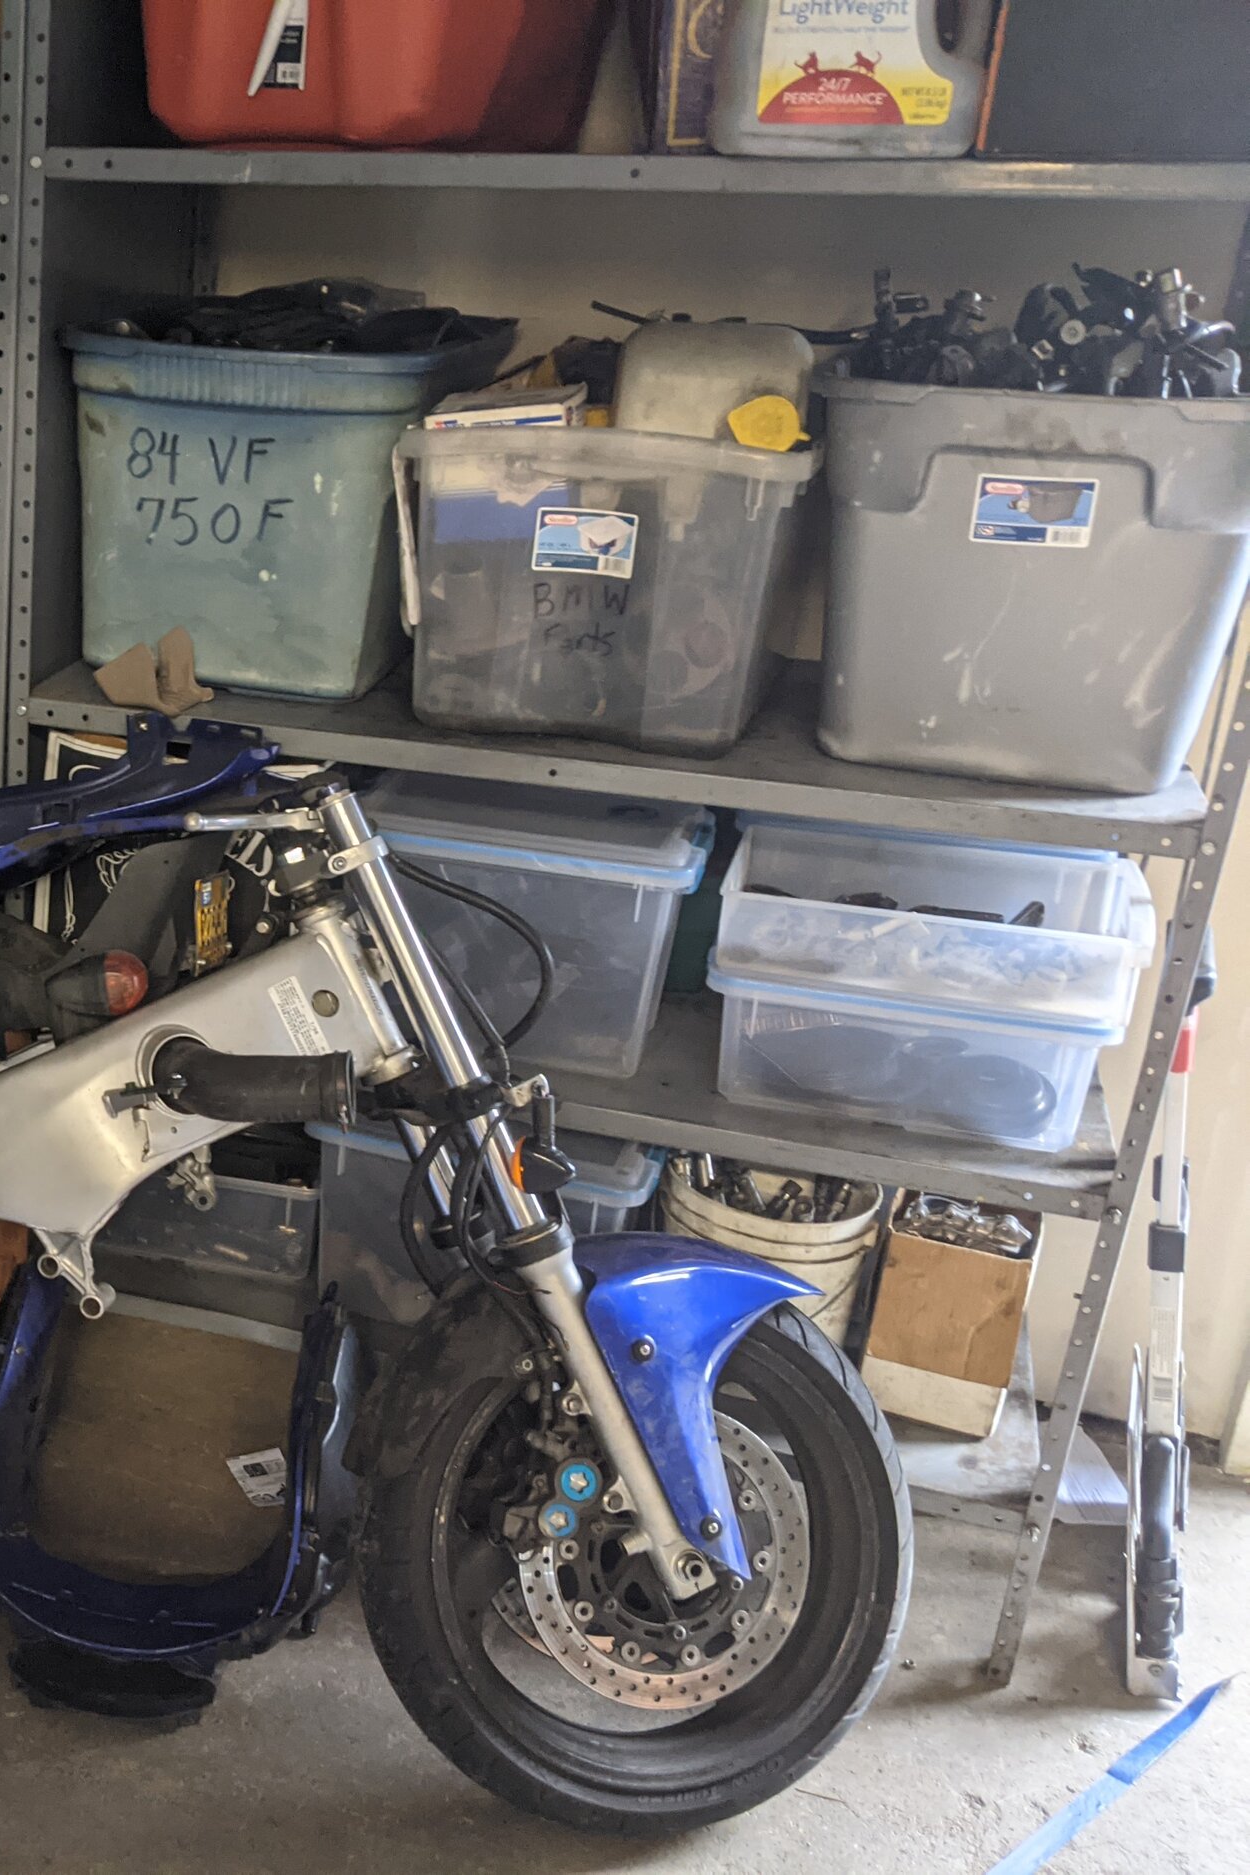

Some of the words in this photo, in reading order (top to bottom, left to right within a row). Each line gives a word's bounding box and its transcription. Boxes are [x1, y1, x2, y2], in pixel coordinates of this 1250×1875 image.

[779, 0, 908, 24] LightWeight
[818, 77, 852, 91] 24/7
[782, 92, 885, 106] PERFORMANCE
[127, 427, 180, 485] 84
[209, 436, 277, 485] VF
[533, 582, 630, 619] BMW
